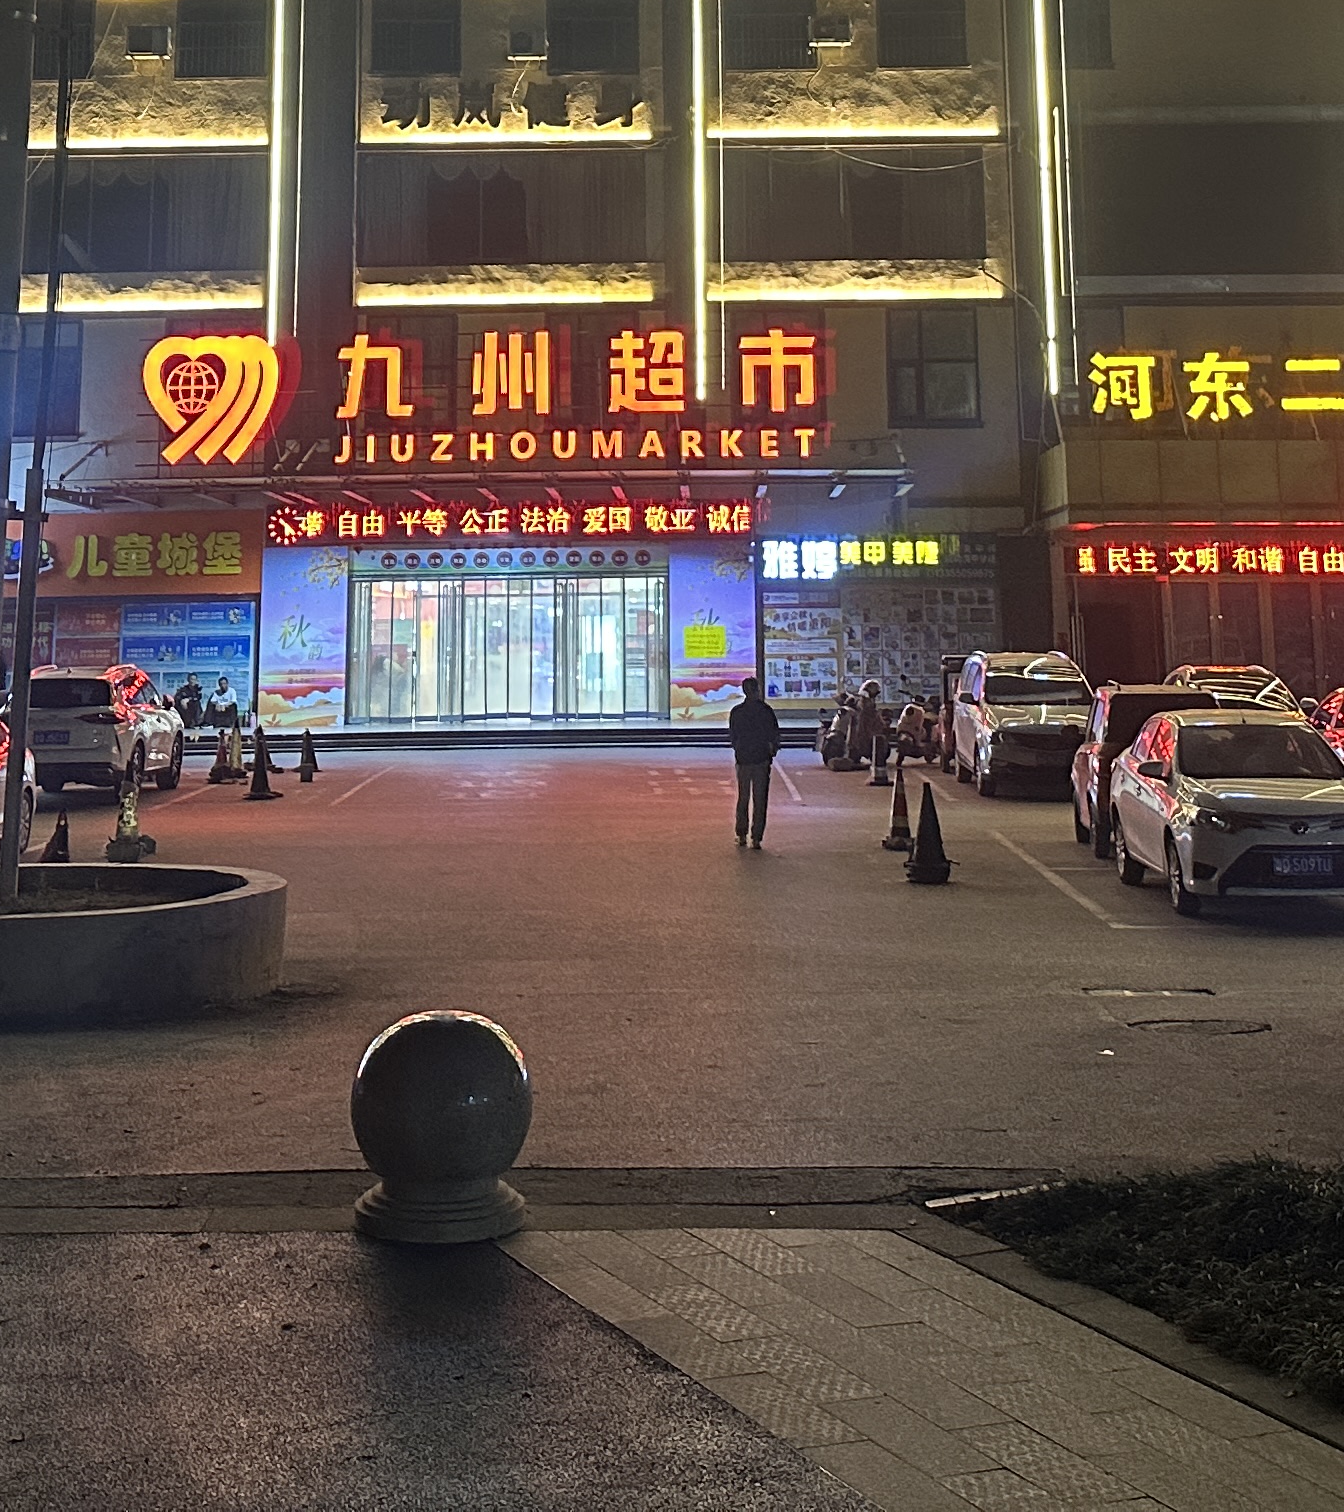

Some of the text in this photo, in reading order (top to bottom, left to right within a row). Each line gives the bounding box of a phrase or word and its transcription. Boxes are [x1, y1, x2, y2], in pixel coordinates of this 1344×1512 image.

[337, 328, 816, 418] 九州超市
[335, 428, 817, 464] JIUZHOUMARKET
[337, 509, 385, 537] 自由
[396, 508, 448, 536] 平等
[459, 507, 510, 535] 公正
[520, 506, 570, 534] 法治
[582, 506, 631, 534] 爱国
[644, 506, 694, 533] 敬业
[707, 505, 752, 534] 诚信
[66, 531, 243, 579] 儿童城堡
[840, 540, 886, 566] 美甲
[1108, 546, 1158, 575] 民主
[1169, 546, 1221, 575] 文明
[1231, 545, 1284, 575] 和谐
